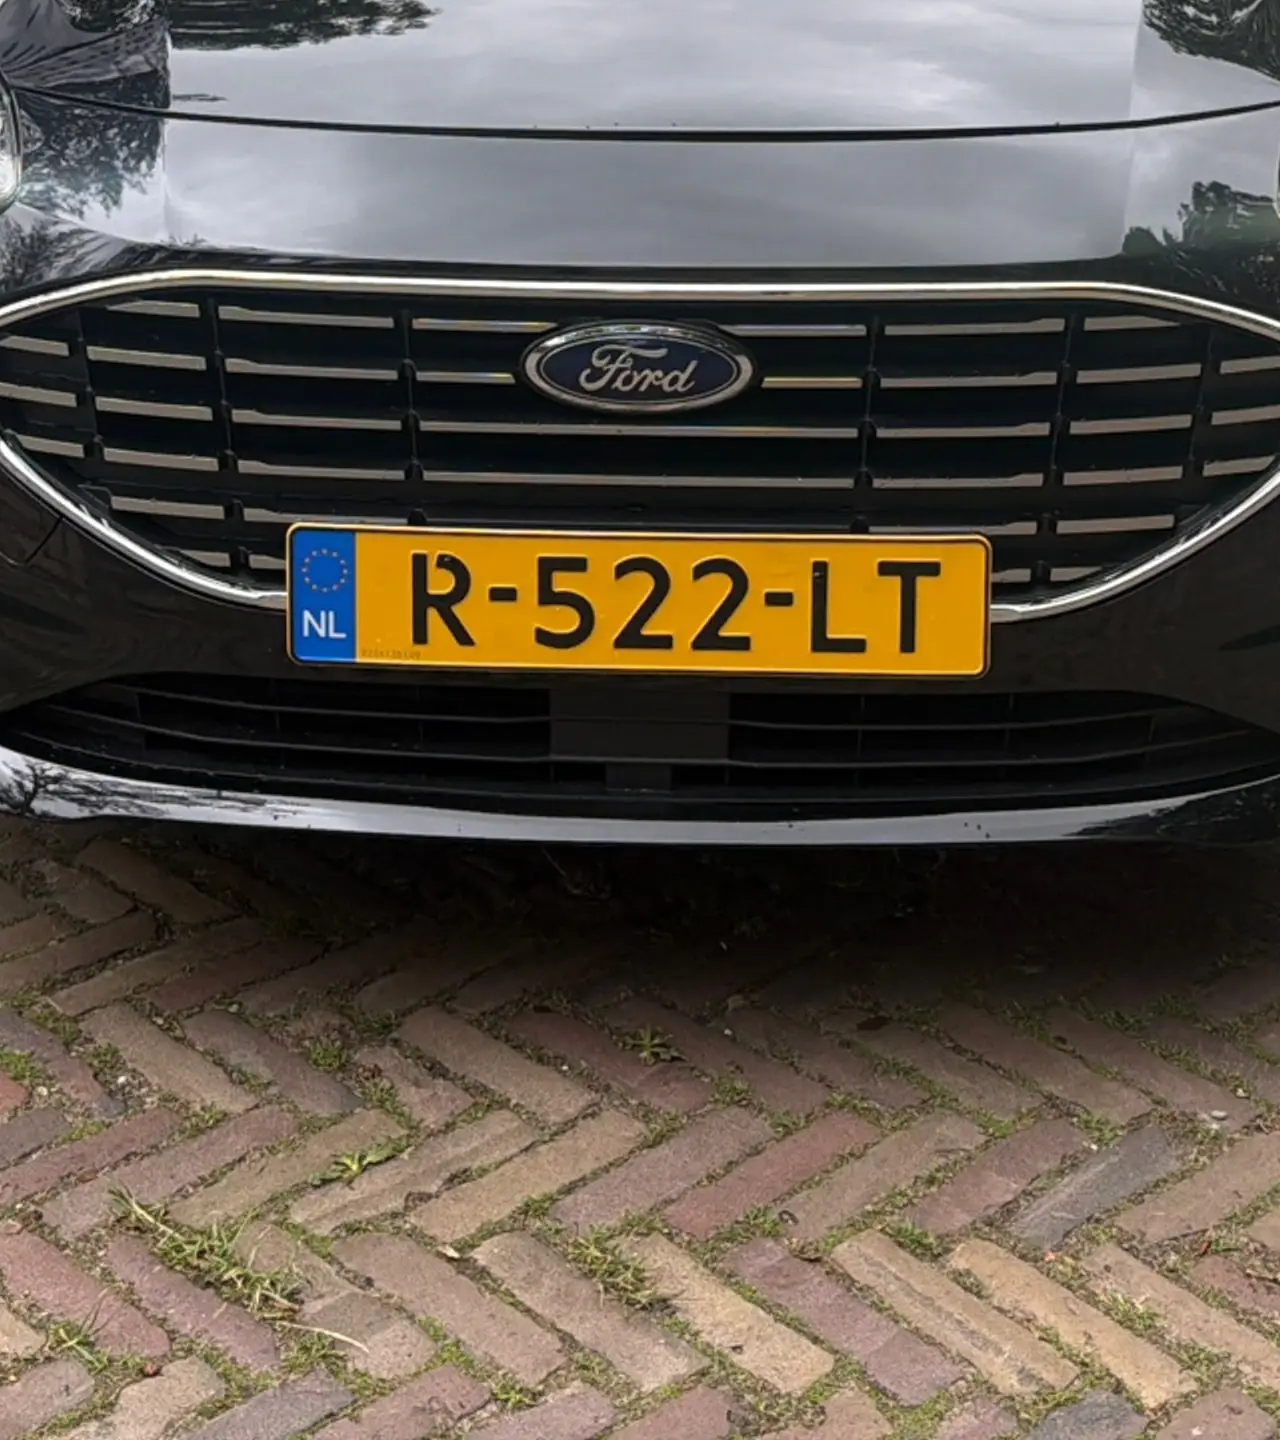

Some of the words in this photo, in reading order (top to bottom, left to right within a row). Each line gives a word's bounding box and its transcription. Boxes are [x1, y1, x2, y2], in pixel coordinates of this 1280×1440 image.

[578, 343, 699, 393] Ford
[303, 609, 348, 640] NL
[411, 552, 942, 654] R-522-LT
